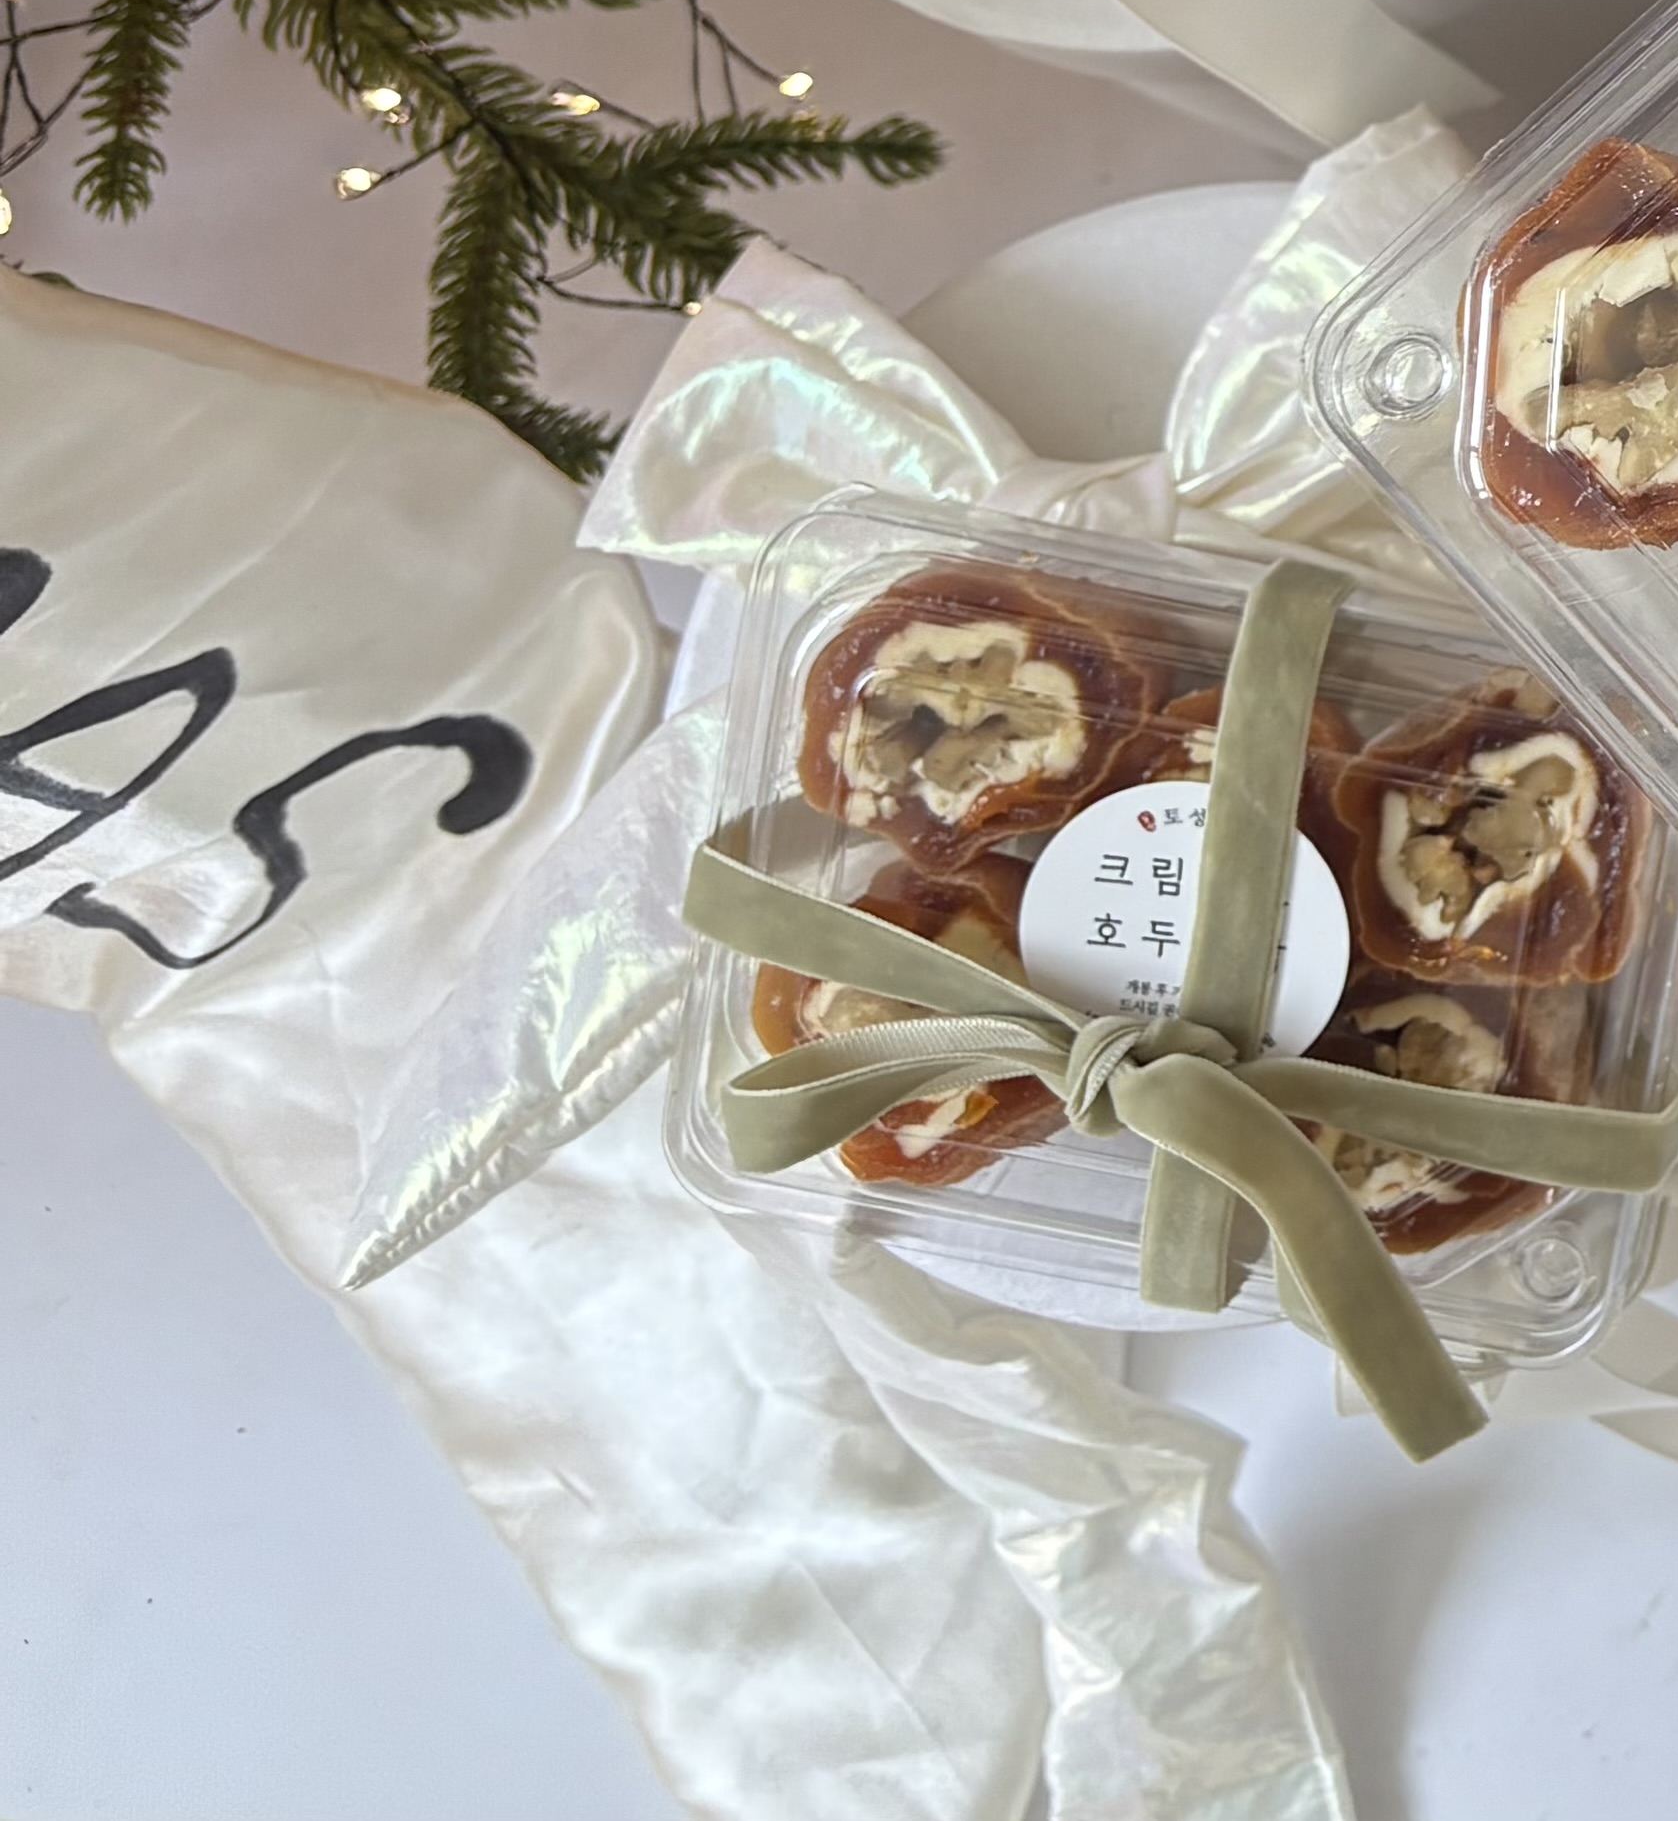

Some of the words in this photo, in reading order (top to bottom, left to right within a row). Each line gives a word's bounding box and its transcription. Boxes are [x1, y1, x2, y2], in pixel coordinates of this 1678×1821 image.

[1163, 808, 1206, 827] 토성
[1094, 854, 1184, 896] 크림
[1087, 912, 1180, 958] 호두
